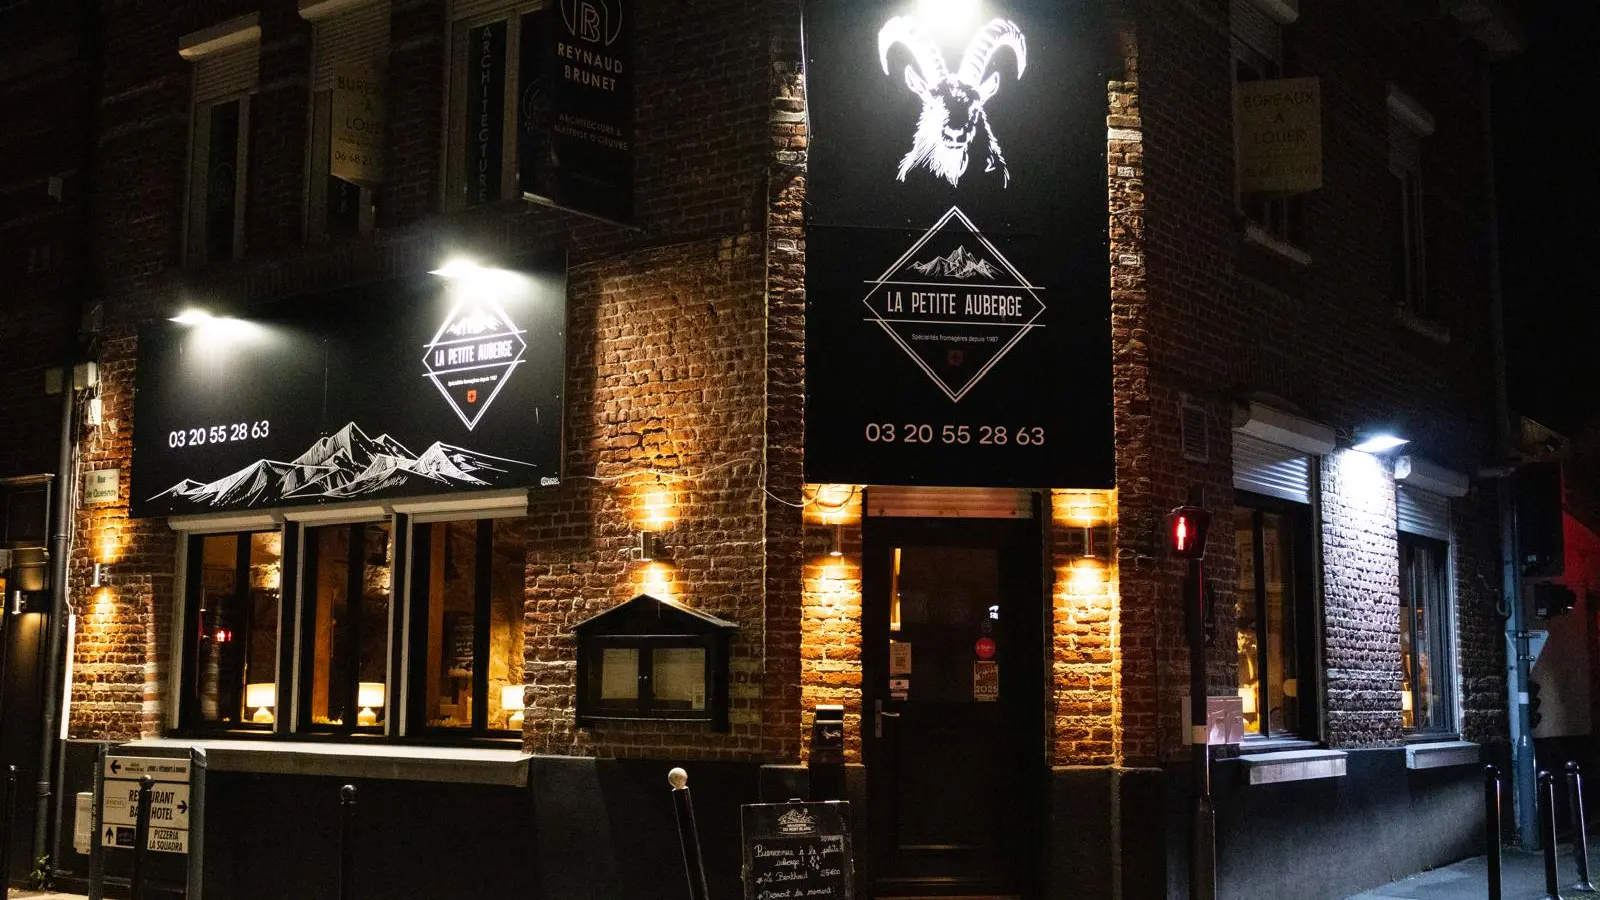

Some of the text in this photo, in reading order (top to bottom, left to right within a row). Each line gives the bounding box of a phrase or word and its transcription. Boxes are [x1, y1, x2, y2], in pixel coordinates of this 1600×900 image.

[557, 42, 624, 74] REYNAUD
[564, 64, 617, 92] BRUNET
[1243, 91, 1314, 109] BUREAUX
[478, 25, 493, 202] ARCHITECTURE
[1254, 129, 1307, 145] LOUER
[887, 291, 1023, 318] LA PETITE AUBERGE
[911, 333, 939, 342] Spécialités
[939, 334, 968, 343] fromagères
[968, 335, 985, 344] depuis
[435, 339, 513, 367] LA PETITE AUBERGE
[168, 420, 270, 448] 03 20 55 28 63
[865, 423, 1045, 446] 03 20 55 28 63
[975, 685, 998, 694] 2025
[151, 807, 173, 820] HOTEL
[154, 829, 179, 840] PIZZERIA
[149, 841, 183, 851] LA SQUADRA
